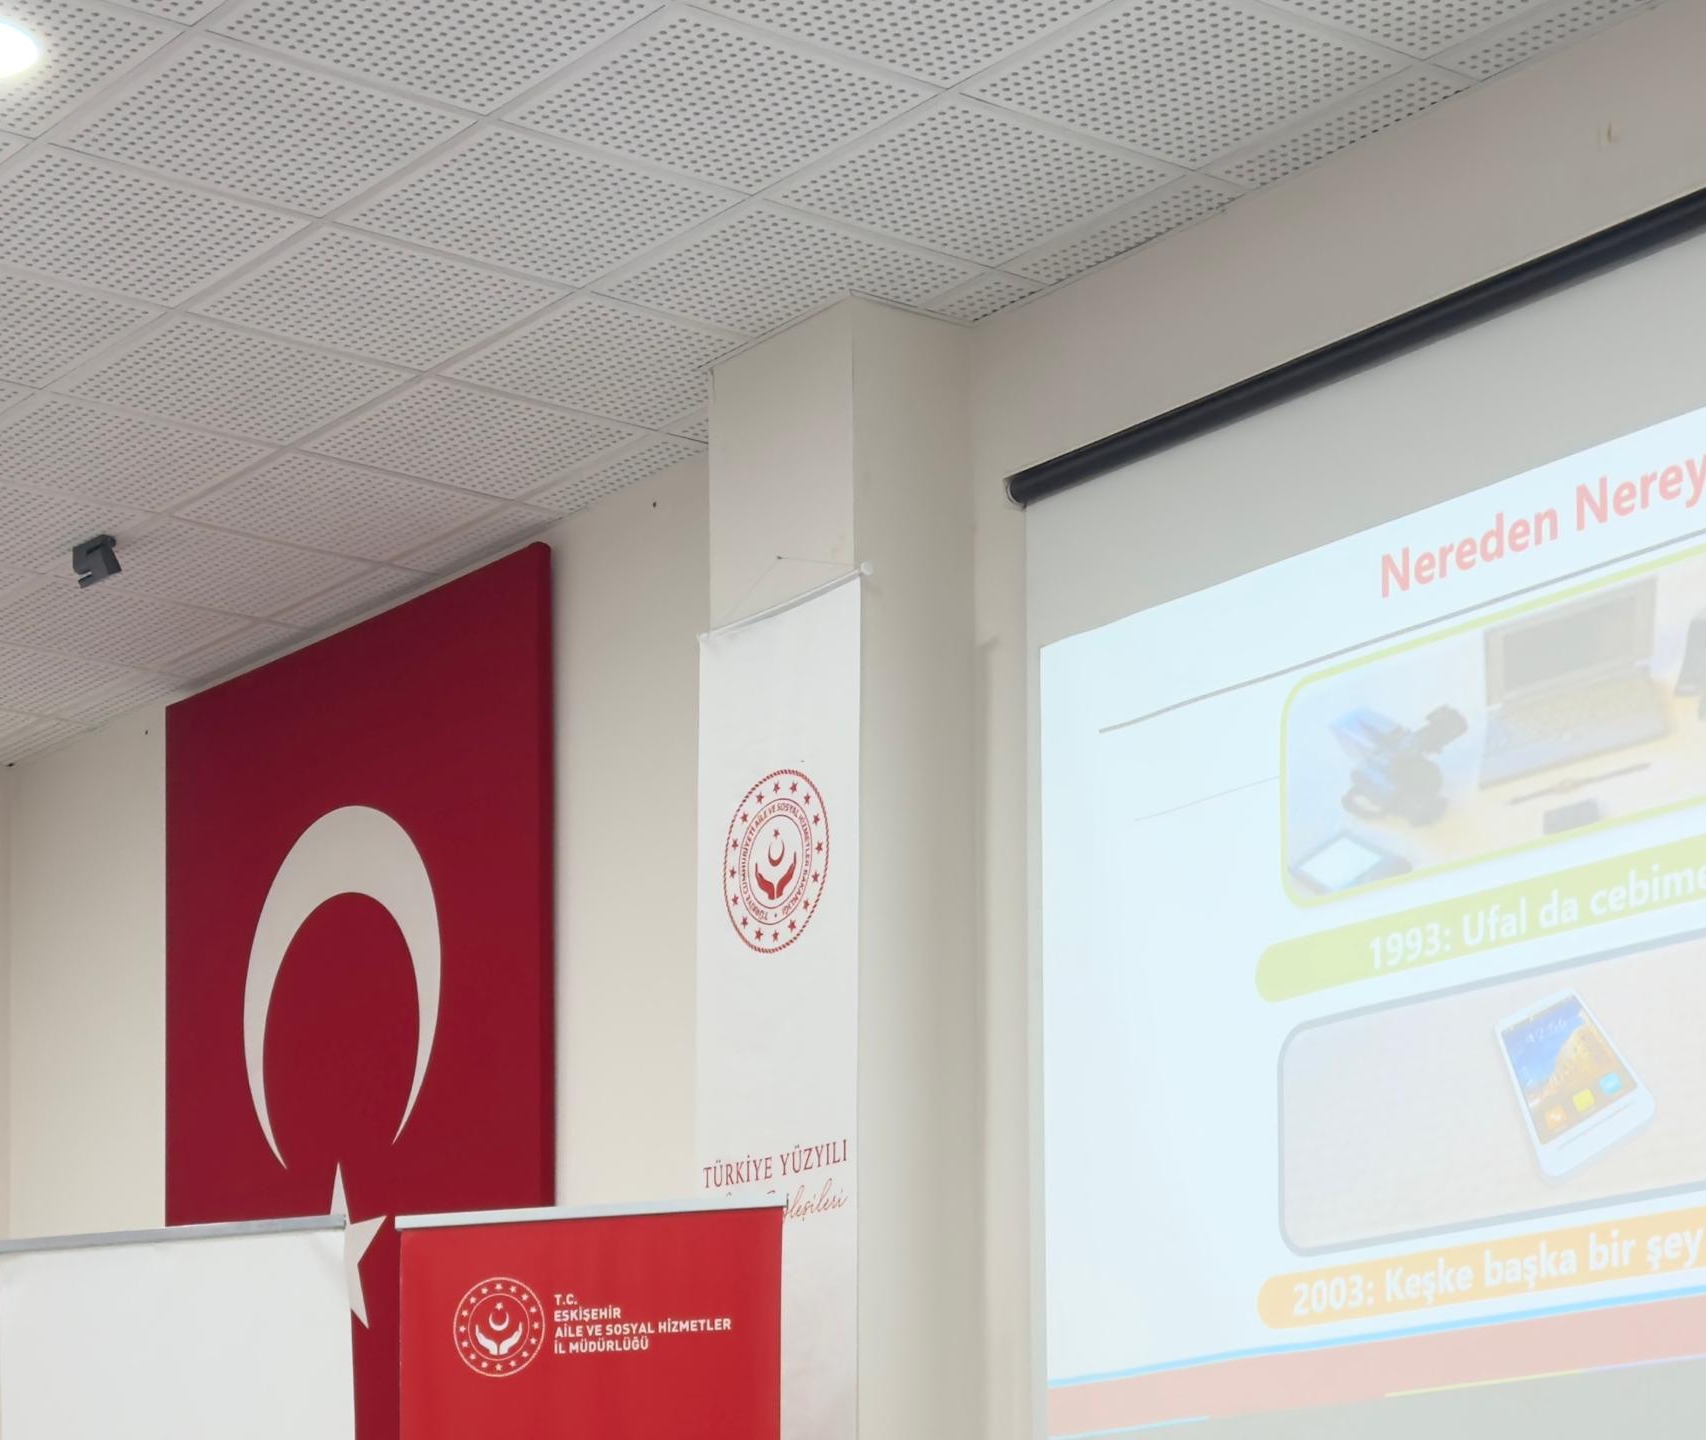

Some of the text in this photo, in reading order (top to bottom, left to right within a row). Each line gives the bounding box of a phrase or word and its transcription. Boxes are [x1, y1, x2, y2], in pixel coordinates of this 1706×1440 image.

[1381, 508, 1558, 599] Nereden
[1368, 922, 1452, 971] 1993:
[1462, 895, 1528, 946] Ufal
[1539, 889, 1579, 929] da
[703, 1139, 848, 1188] TÜRKİYE YÜZYILI
[1292, 1275, 1375, 1317] 2003:
[1384, 1261, 1474, 1305] Keşke
[1484, 1246, 1578, 1292] başka
[1588, 1229, 1636, 1272] bir
[1646, 1223, 1704, 1272] şey
[554, 1293, 578, 1306] T.C.
[554, 1307, 622, 1323] ESKİŞEHİR
[555, 1316, 732, 1338] AİLE VE SOSYAL HİZMETLER
[554, 1335, 650, 1355] İL MÜDÜRLÜĞÜ
